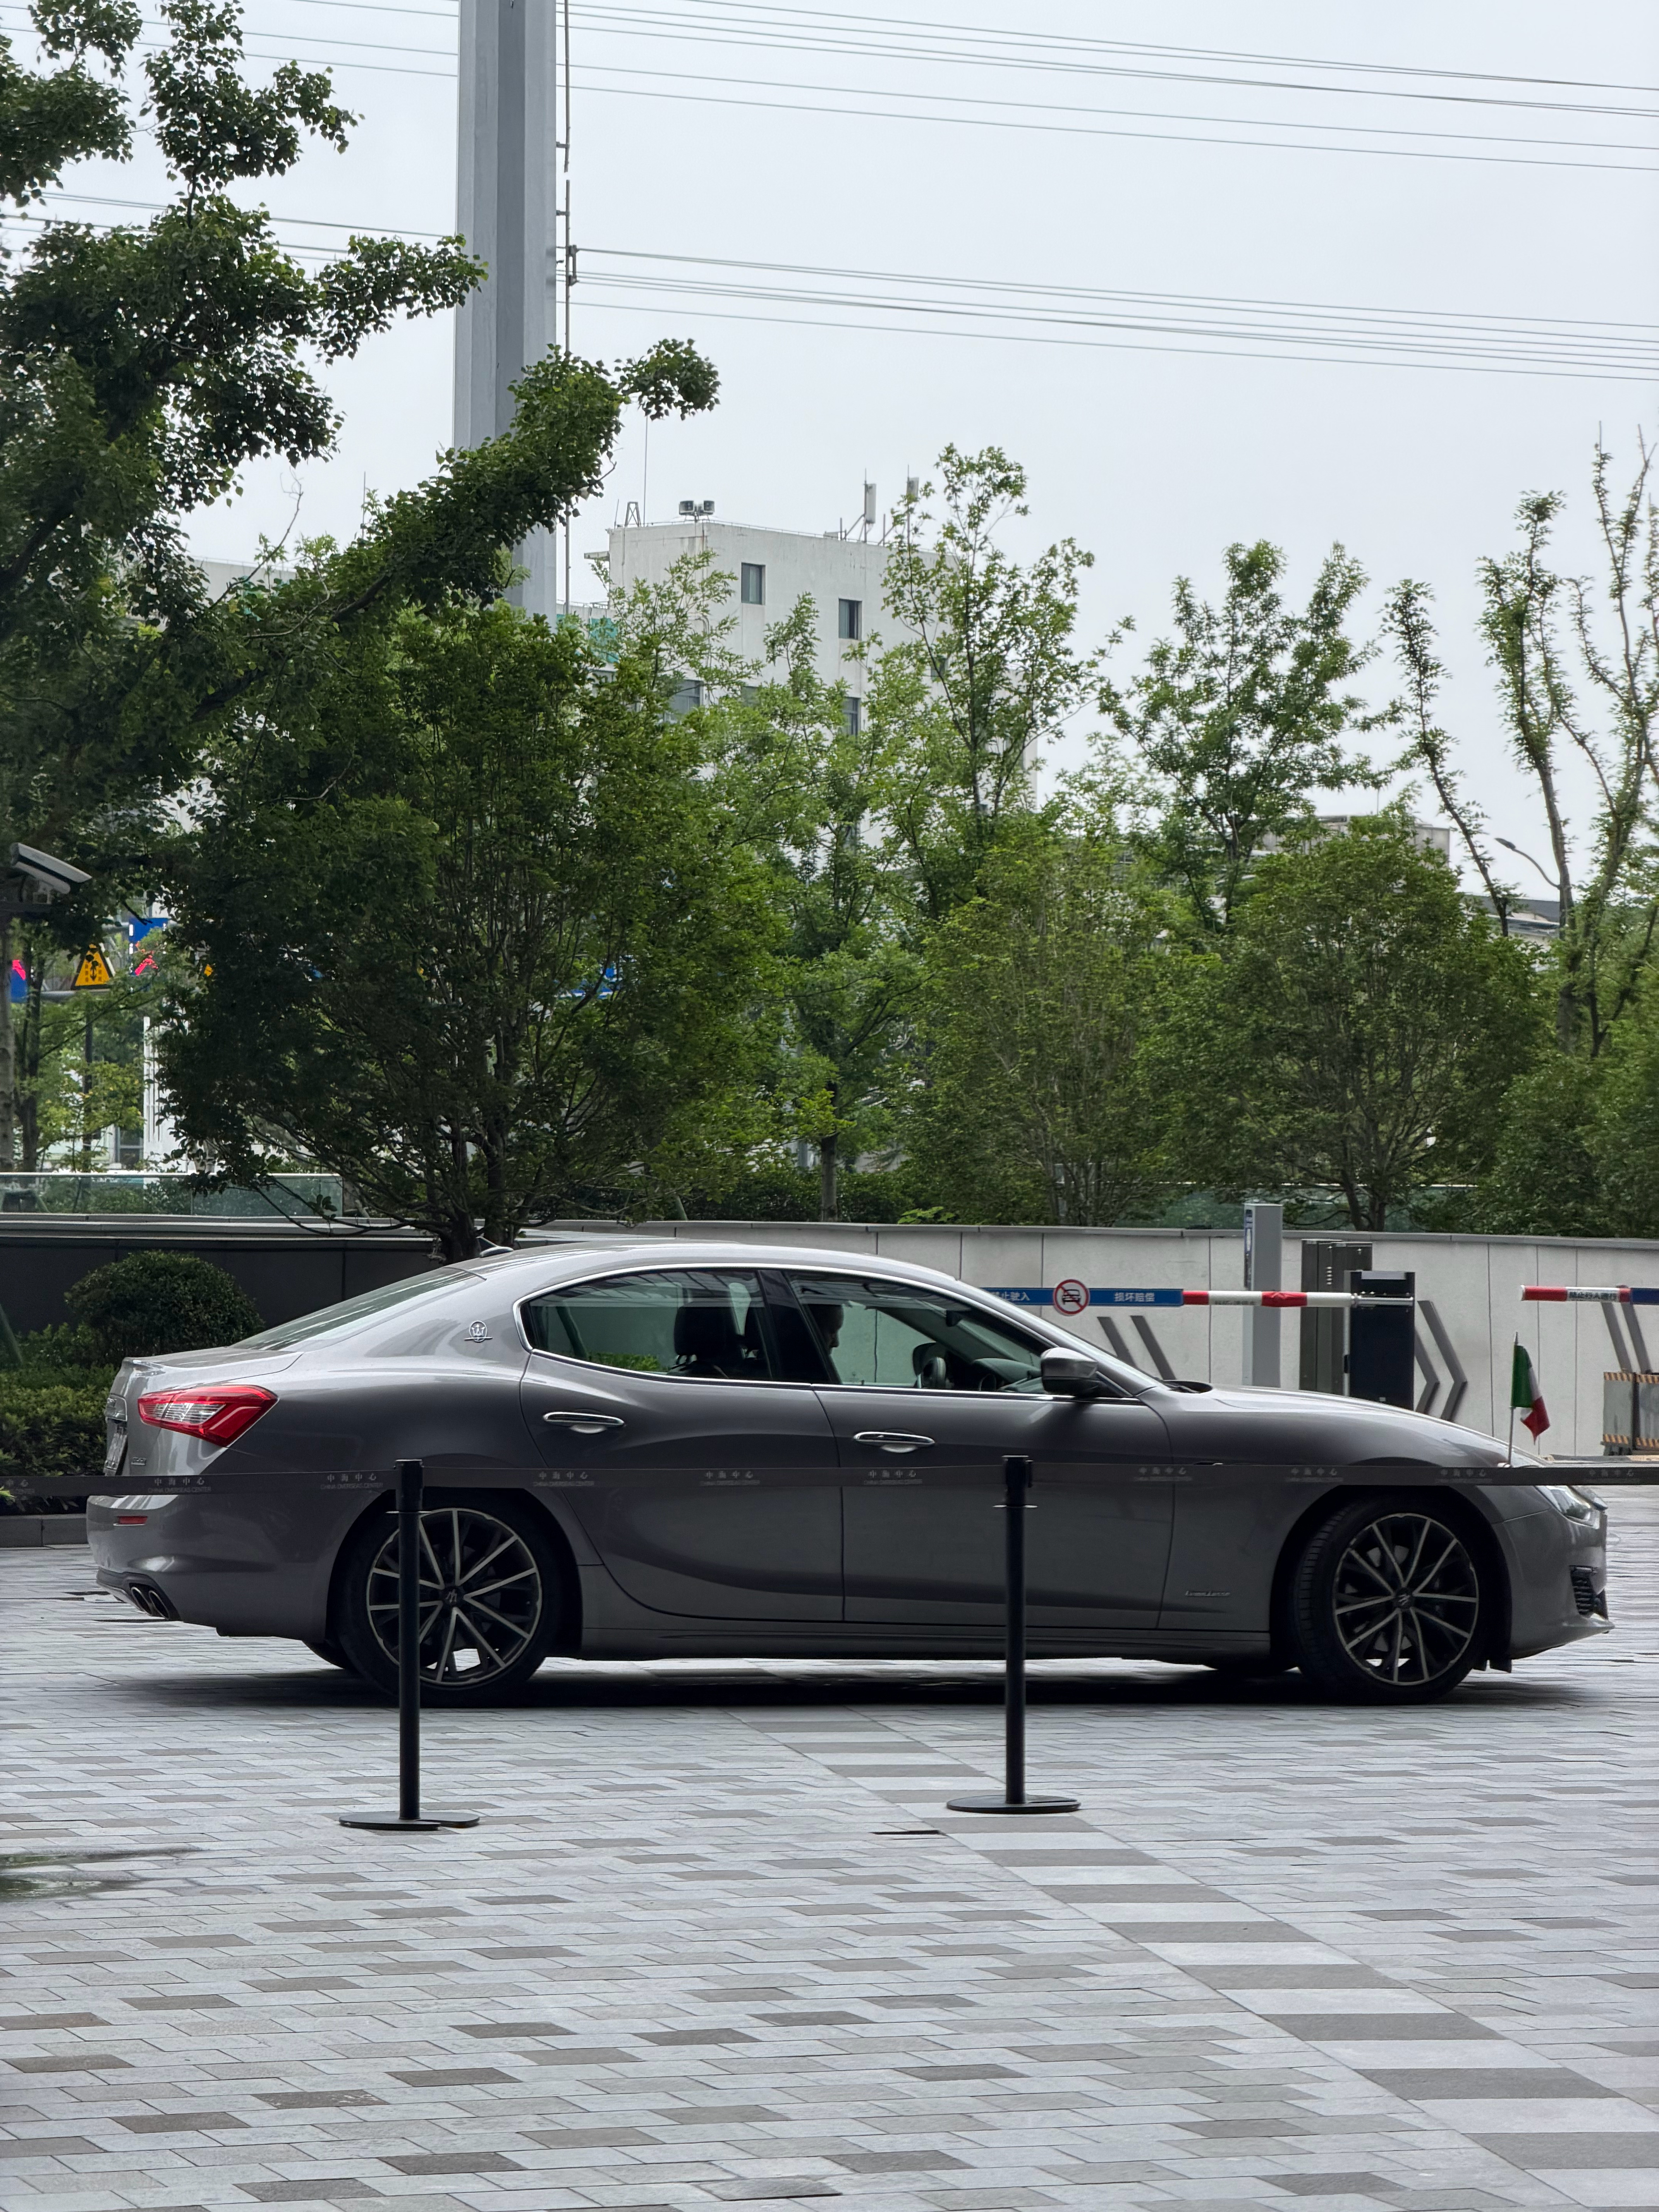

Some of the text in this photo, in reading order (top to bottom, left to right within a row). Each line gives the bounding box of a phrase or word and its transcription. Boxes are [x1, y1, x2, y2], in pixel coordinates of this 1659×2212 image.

[1114, 1292, 1155, 1302] 损坏赔偿
[154, 1477, 204, 1486] 中海中心
[327, 1472, 377, 1482] 中海中心
